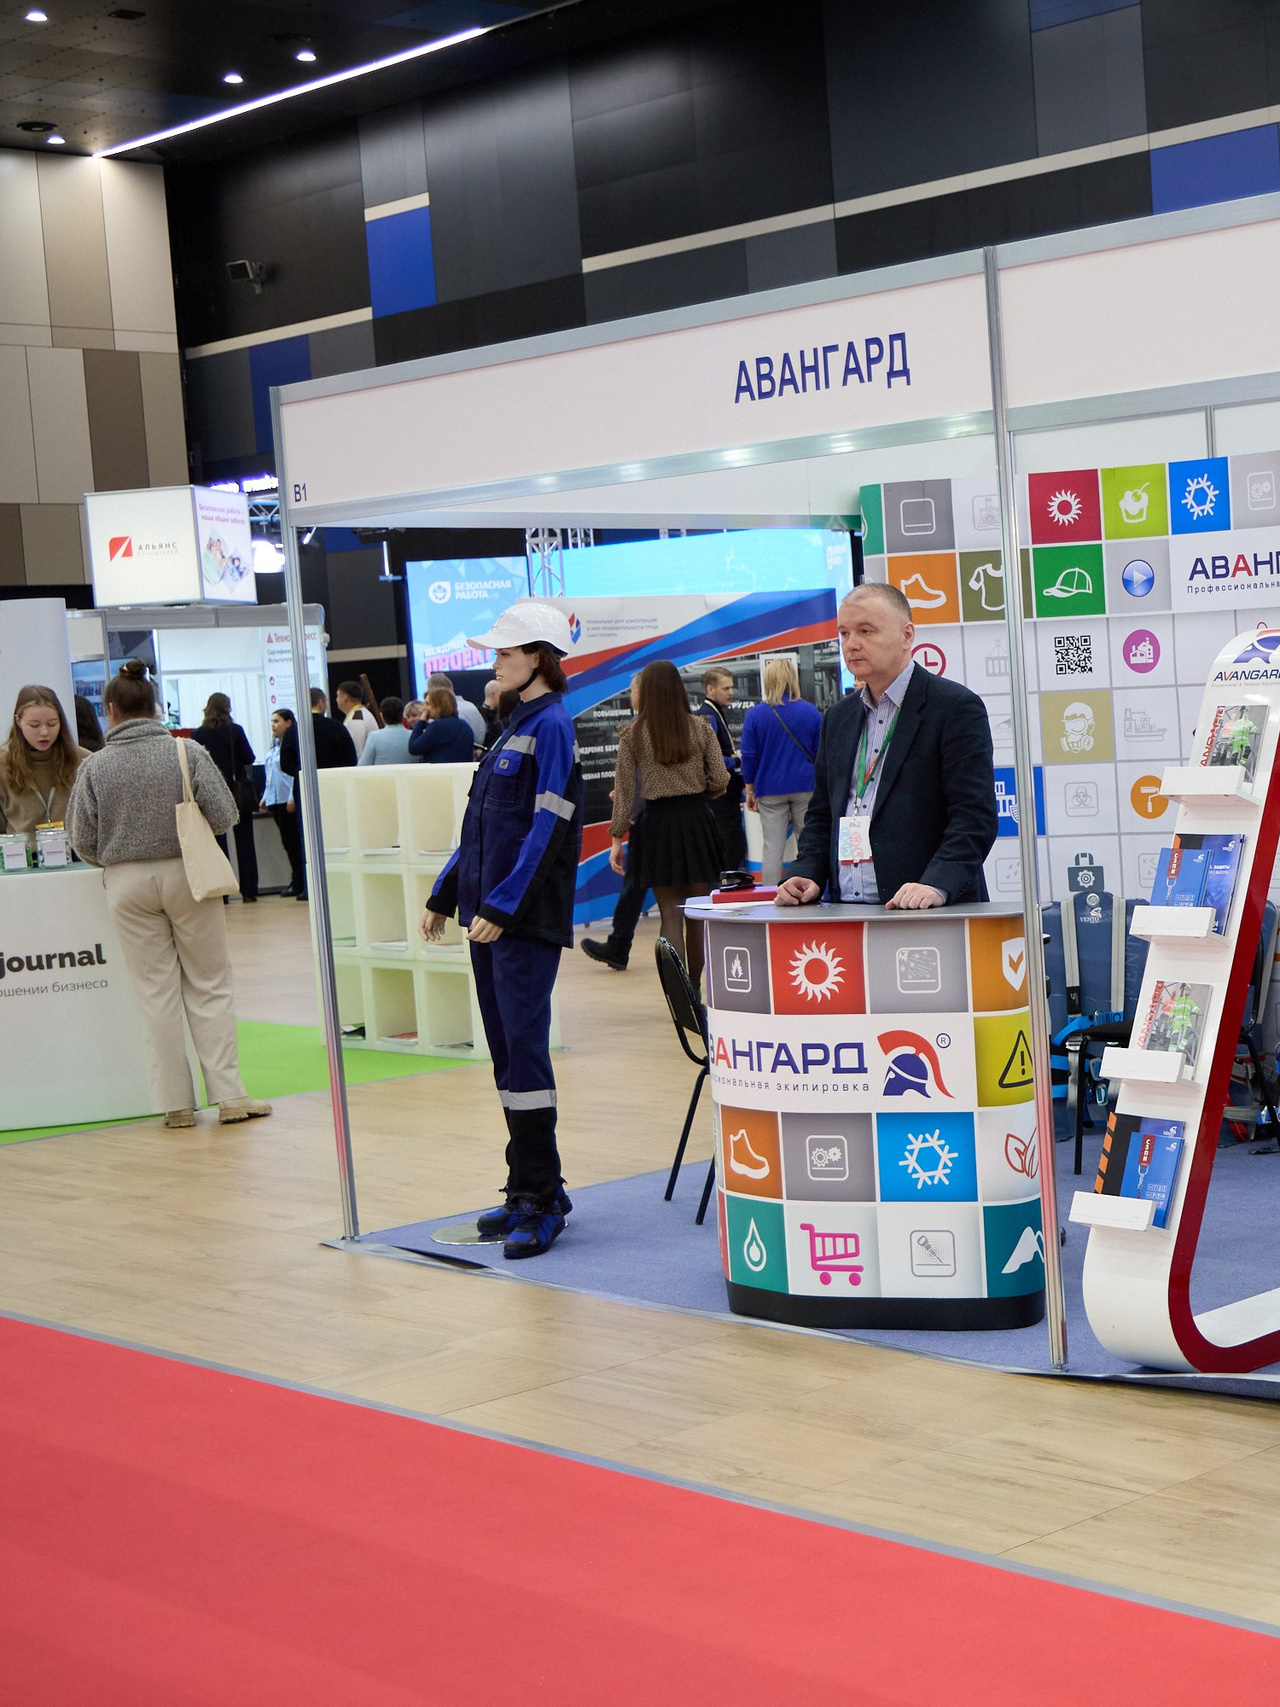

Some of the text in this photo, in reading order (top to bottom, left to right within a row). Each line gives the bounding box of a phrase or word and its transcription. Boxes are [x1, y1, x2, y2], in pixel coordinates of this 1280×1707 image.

[734, 332, 911, 404] АВАНГАРД
[138, 541, 177, 551] АЛЬЯНС
[455, 579, 512, 591] БЕЗОПАСНАЯ
[1200, 705, 1226, 766] ANGARD
[579, 746, 604, 755] НЕДРЕНИЕ
[581, 772, 600, 781] ЧЕБНАЯ
[0, 979, 108, 998] ошении бизнеса
[1137, 981, 1165, 1050] ANGARD
[776, 1081, 870, 1094] экипировка
